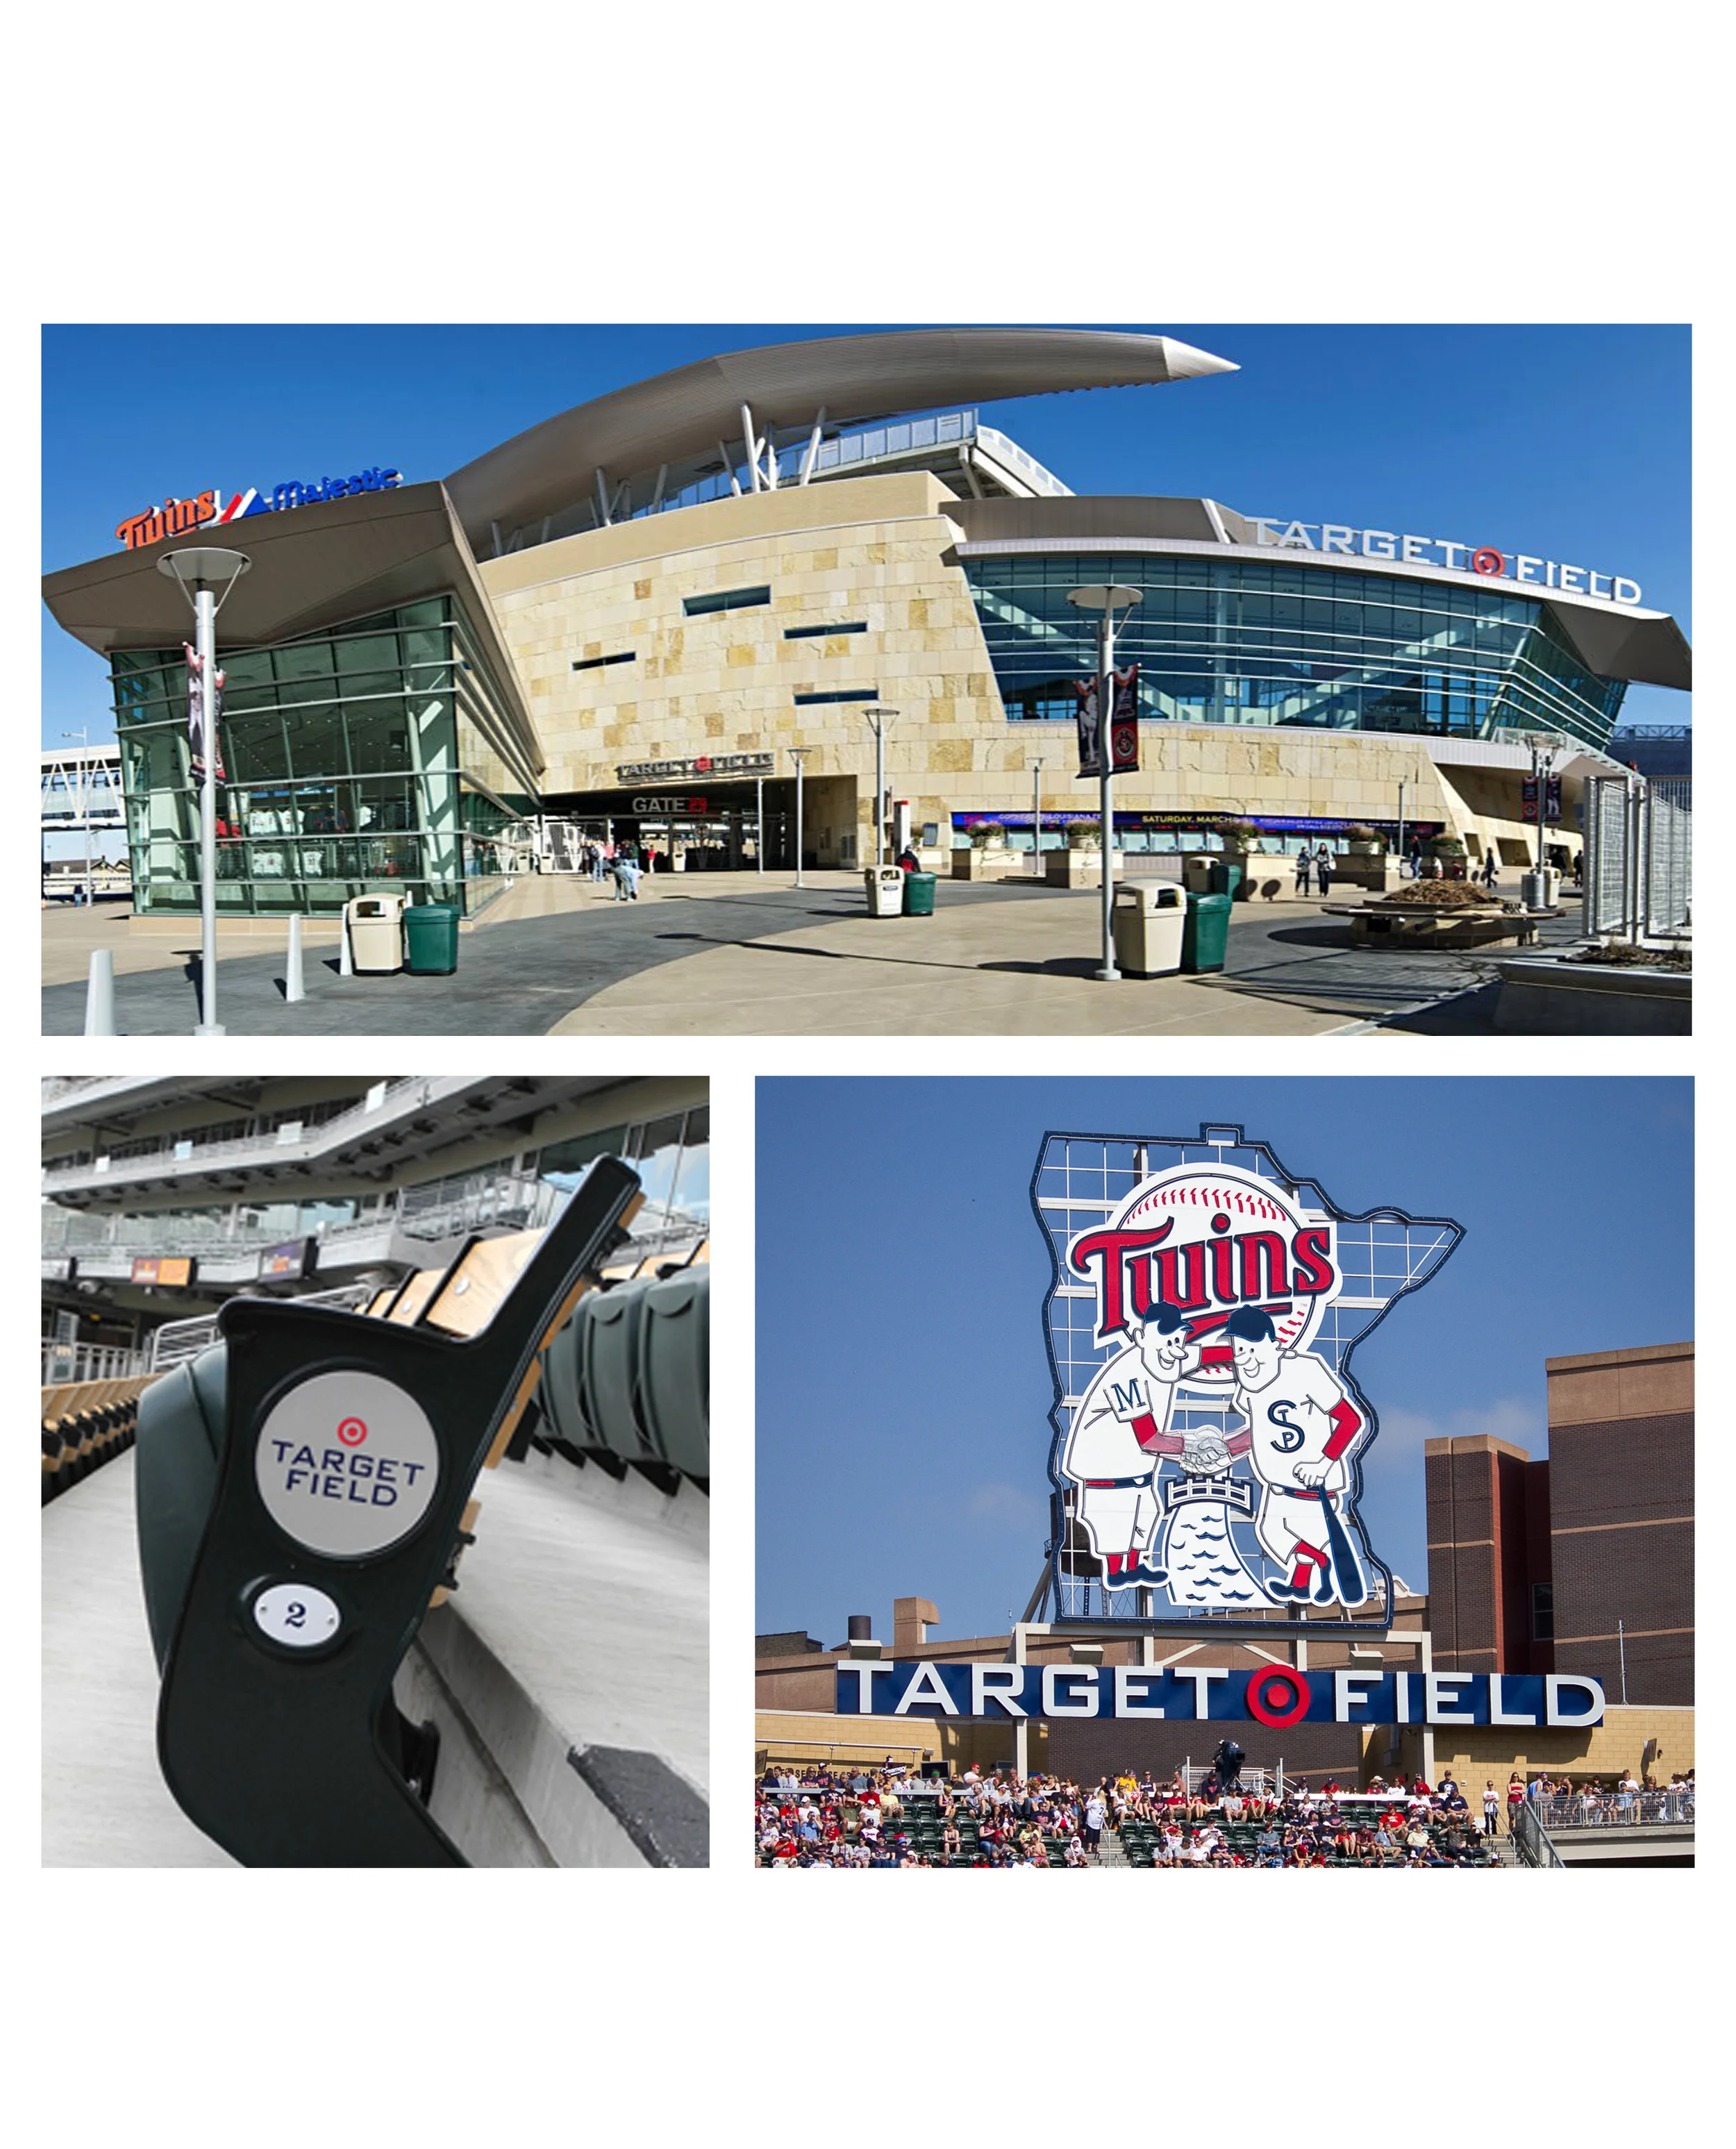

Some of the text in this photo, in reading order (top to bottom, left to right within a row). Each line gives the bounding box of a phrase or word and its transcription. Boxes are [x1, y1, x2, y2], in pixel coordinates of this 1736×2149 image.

[115, 466, 401, 551] Twins Majestic
[1244, 516, 1642, 605] TARGET FIELD
[632, 797, 685, 813] GATE
[1196, 815, 1232, 823] MARCH
[1070, 1212, 1335, 1339] Twins
[1110, 1378, 1146, 1412] M
[272, 1439, 425, 1487] TARGET
[285, 1469, 398, 1507] FIELD
[285, 1601, 306, 1628] 2
[837, 1659, 1605, 1727] TARGET FIELD
